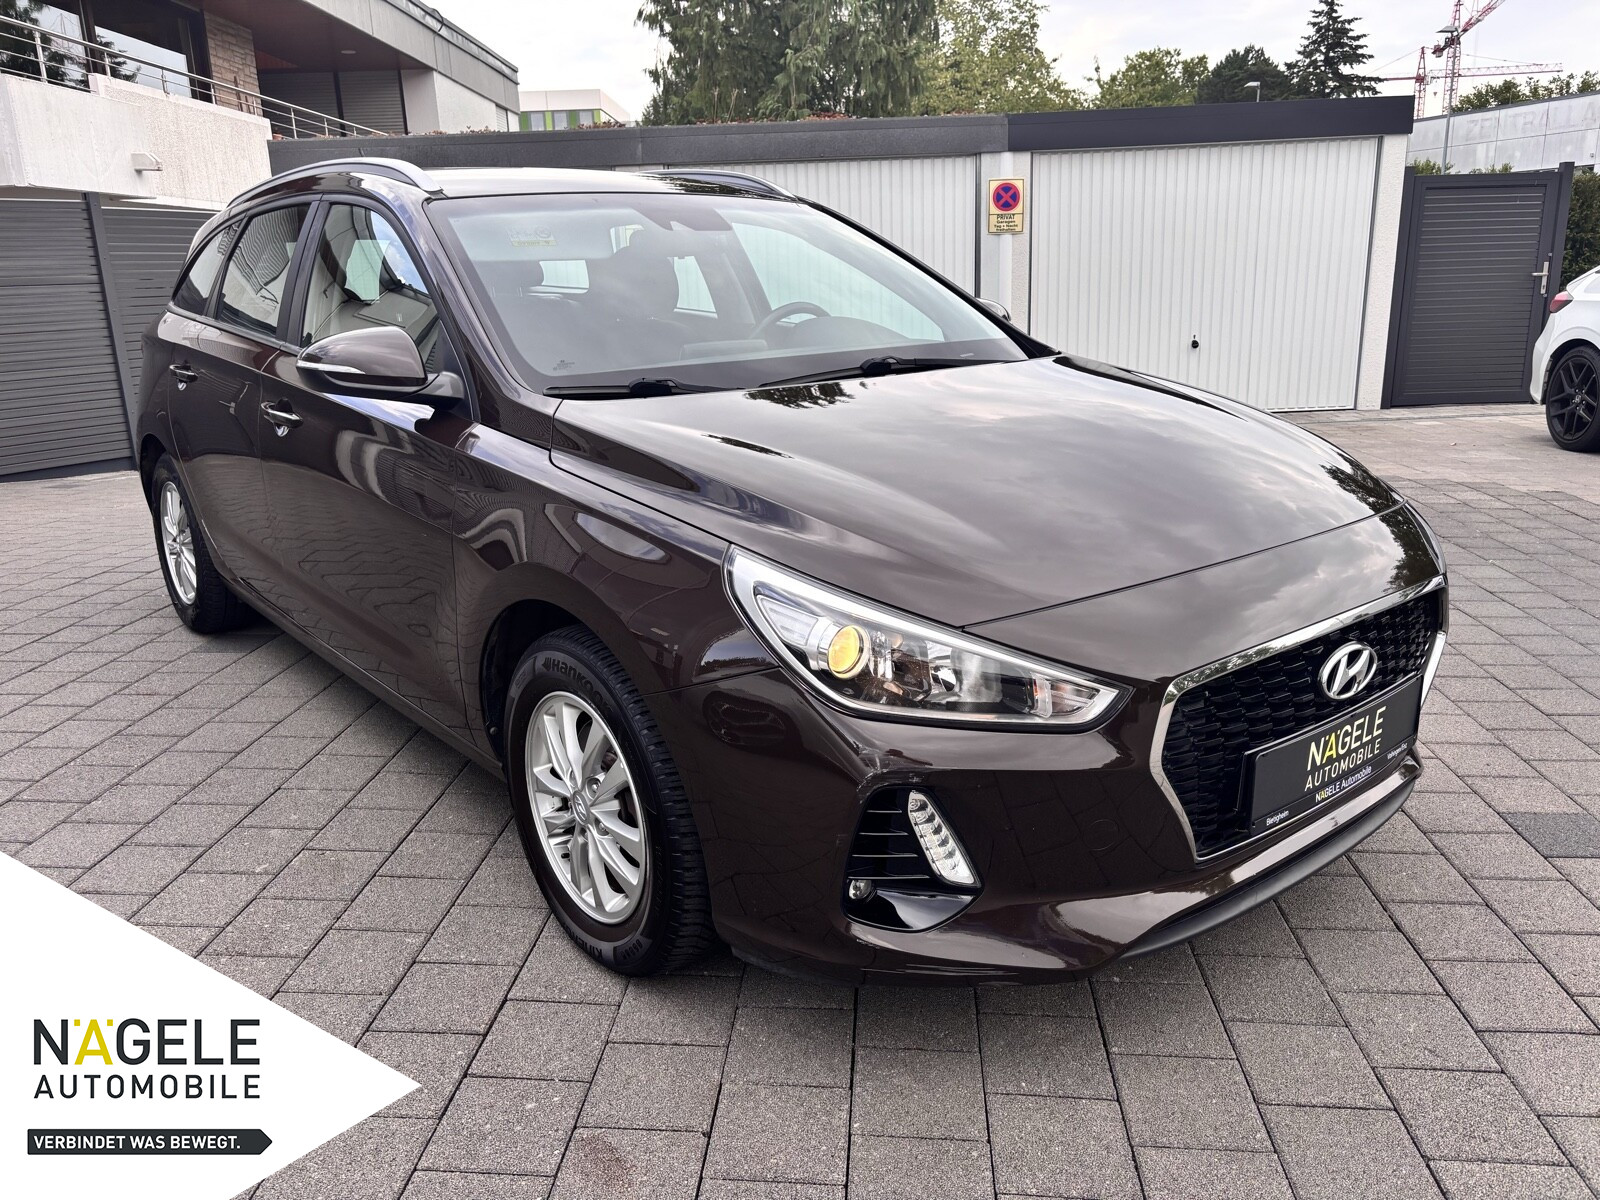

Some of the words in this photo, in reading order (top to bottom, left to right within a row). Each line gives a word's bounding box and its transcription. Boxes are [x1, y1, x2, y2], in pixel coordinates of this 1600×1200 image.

[1304, 738, 1382, 792] AUTOMOBILE
[1306, 706, 1387, 772] NÄGELE
[1315, 782, 1340, 803] NÄGELE
[1340, 766, 1372, 789] Automobile
